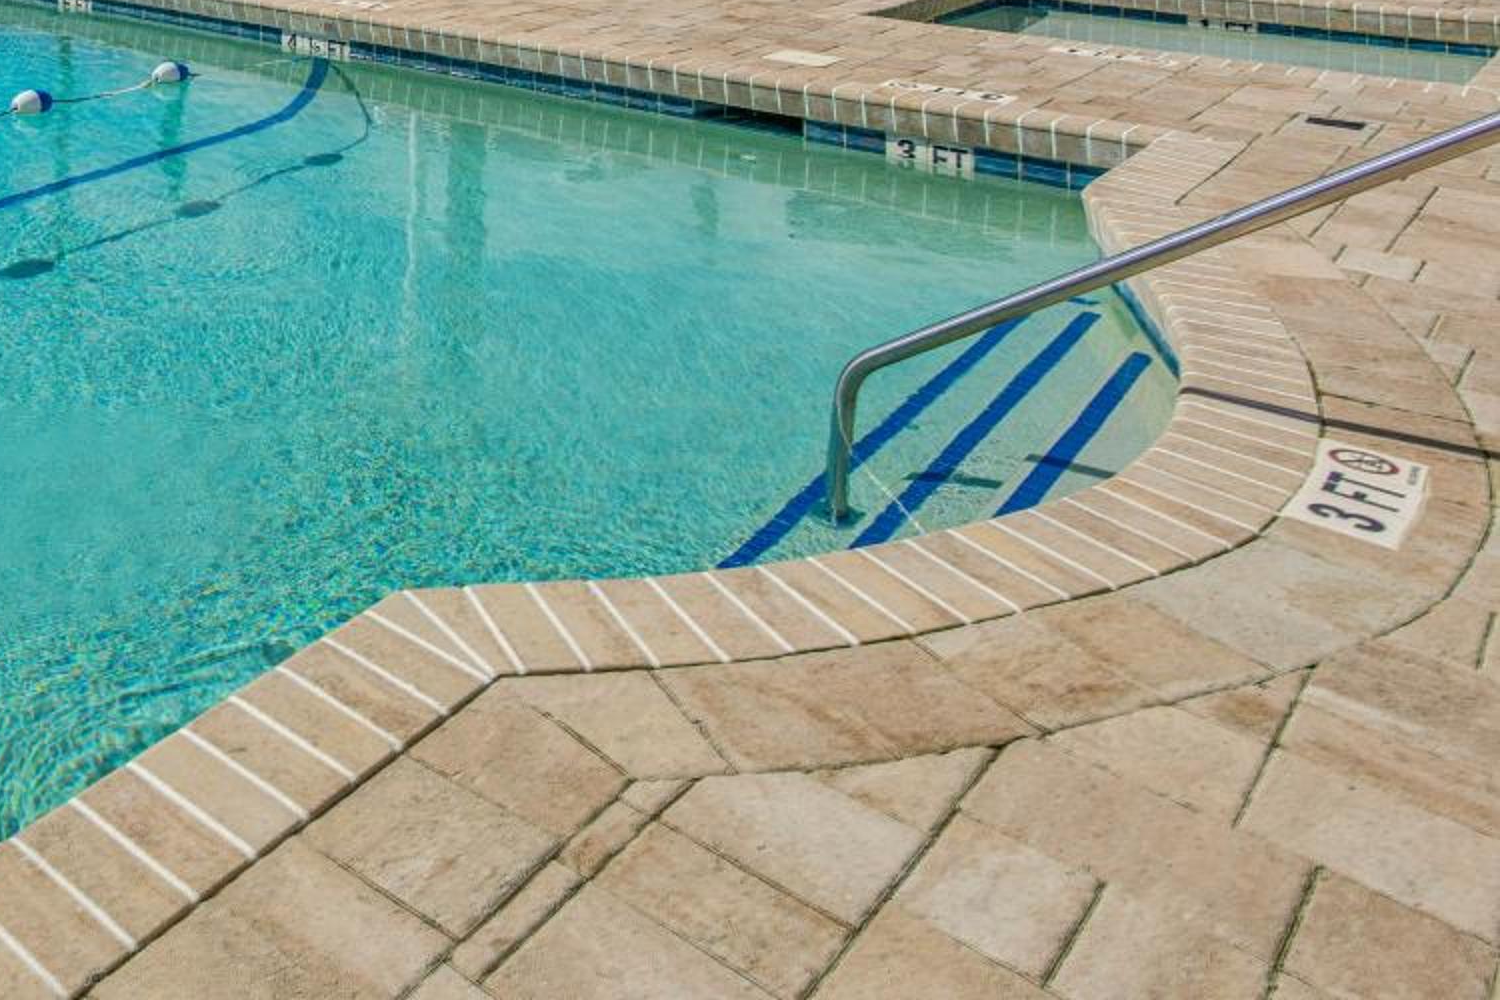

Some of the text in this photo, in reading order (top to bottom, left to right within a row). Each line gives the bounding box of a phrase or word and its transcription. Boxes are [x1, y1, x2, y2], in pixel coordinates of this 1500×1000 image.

[932, 145, 970, 169] FT
[1307, 471, 1408, 533] 3 FT
